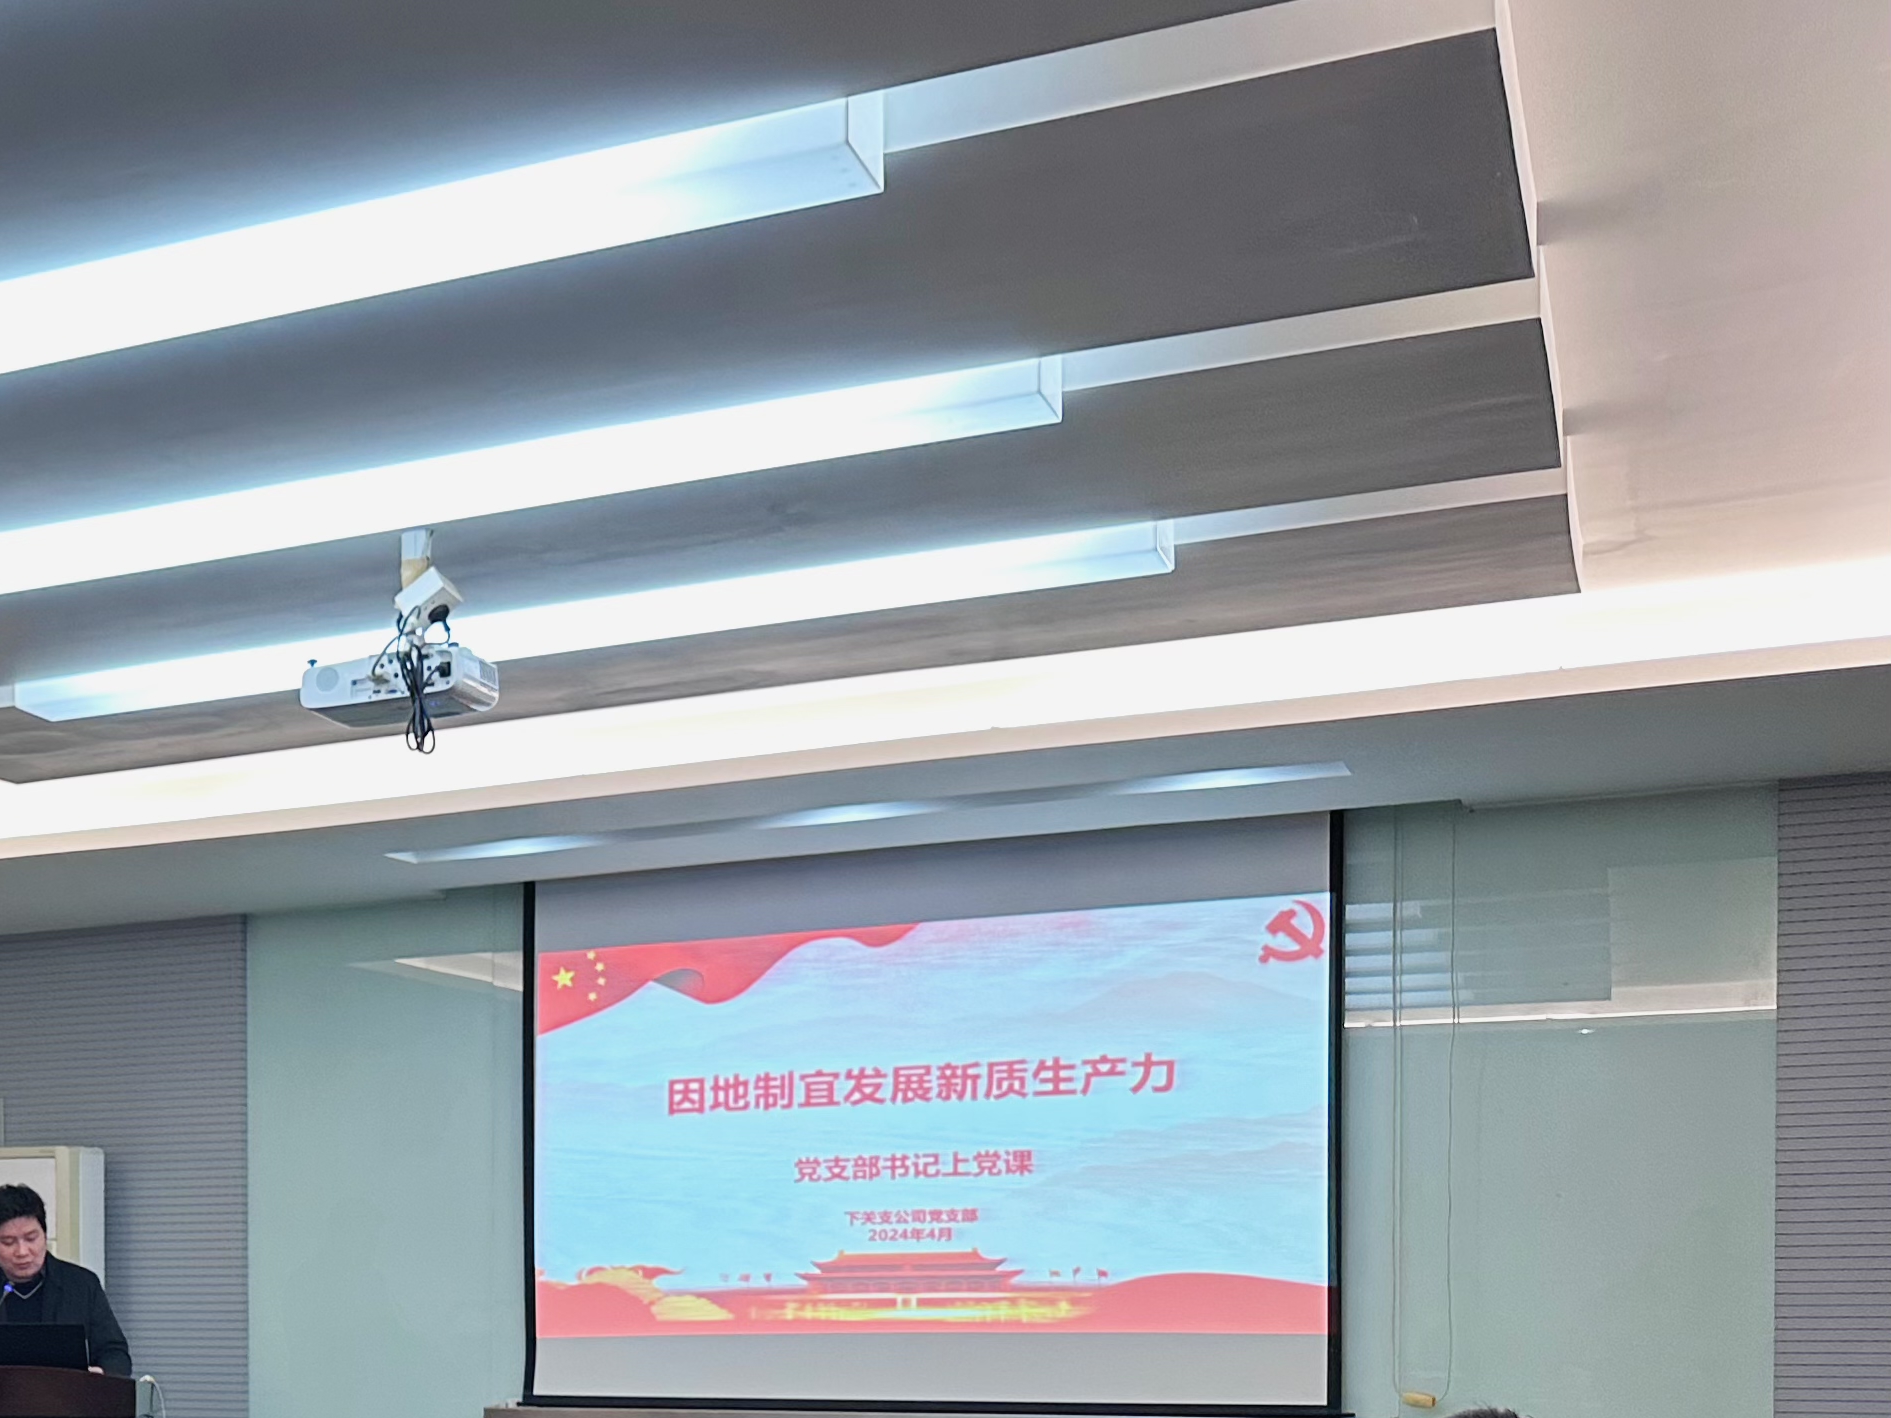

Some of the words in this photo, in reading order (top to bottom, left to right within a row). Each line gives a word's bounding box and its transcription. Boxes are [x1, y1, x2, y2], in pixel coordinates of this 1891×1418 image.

[667, 1052, 1177, 1116] 因地制宜发展新质生产力
[794, 1149, 1034, 1183] 党支部书记上党课
[844, 1207, 979, 1226] 下关支公司党支部
[868, 1227, 953, 1242] 2024年4月
